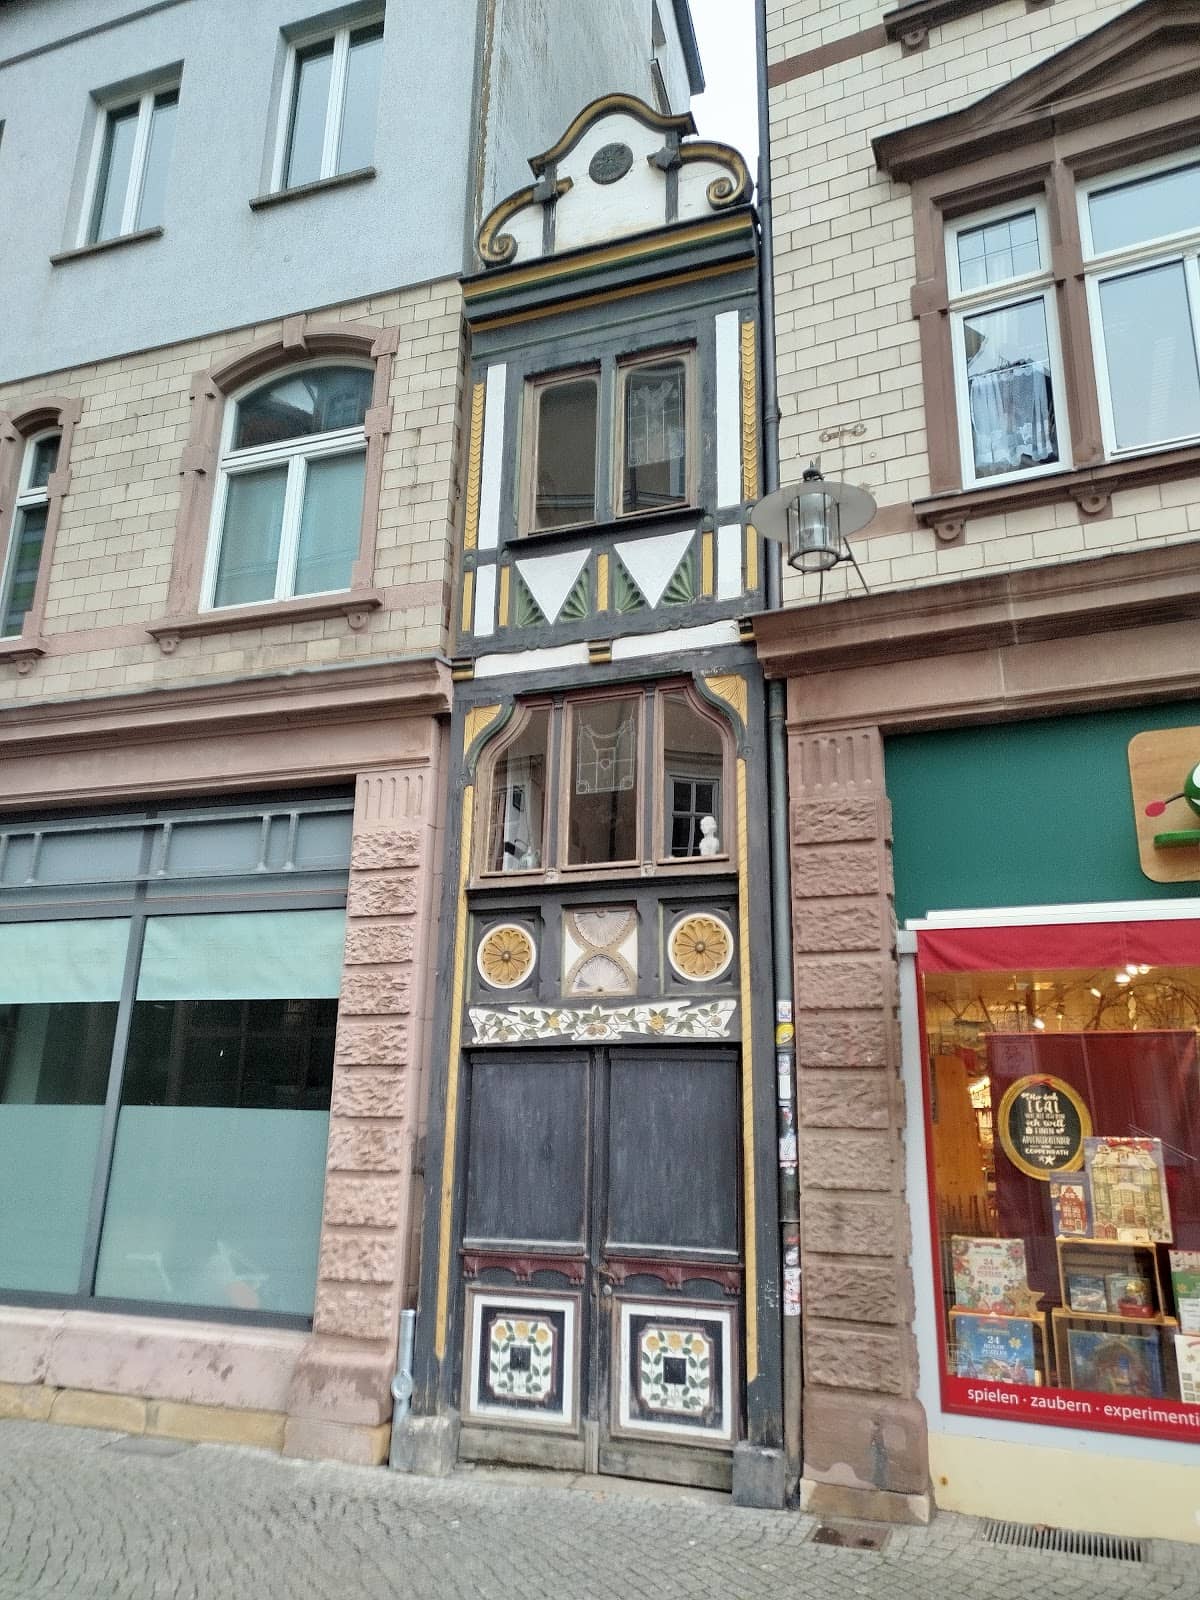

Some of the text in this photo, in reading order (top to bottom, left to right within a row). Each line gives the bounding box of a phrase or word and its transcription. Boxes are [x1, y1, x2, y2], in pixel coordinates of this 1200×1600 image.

[1025, 1148, 1069, 1156] COPPENRATH
[987, 1335, 1000, 1344] 24
[967, 1387, 1019, 1405] spielen
[1030, 1394, 1091, 1414] zaubern
